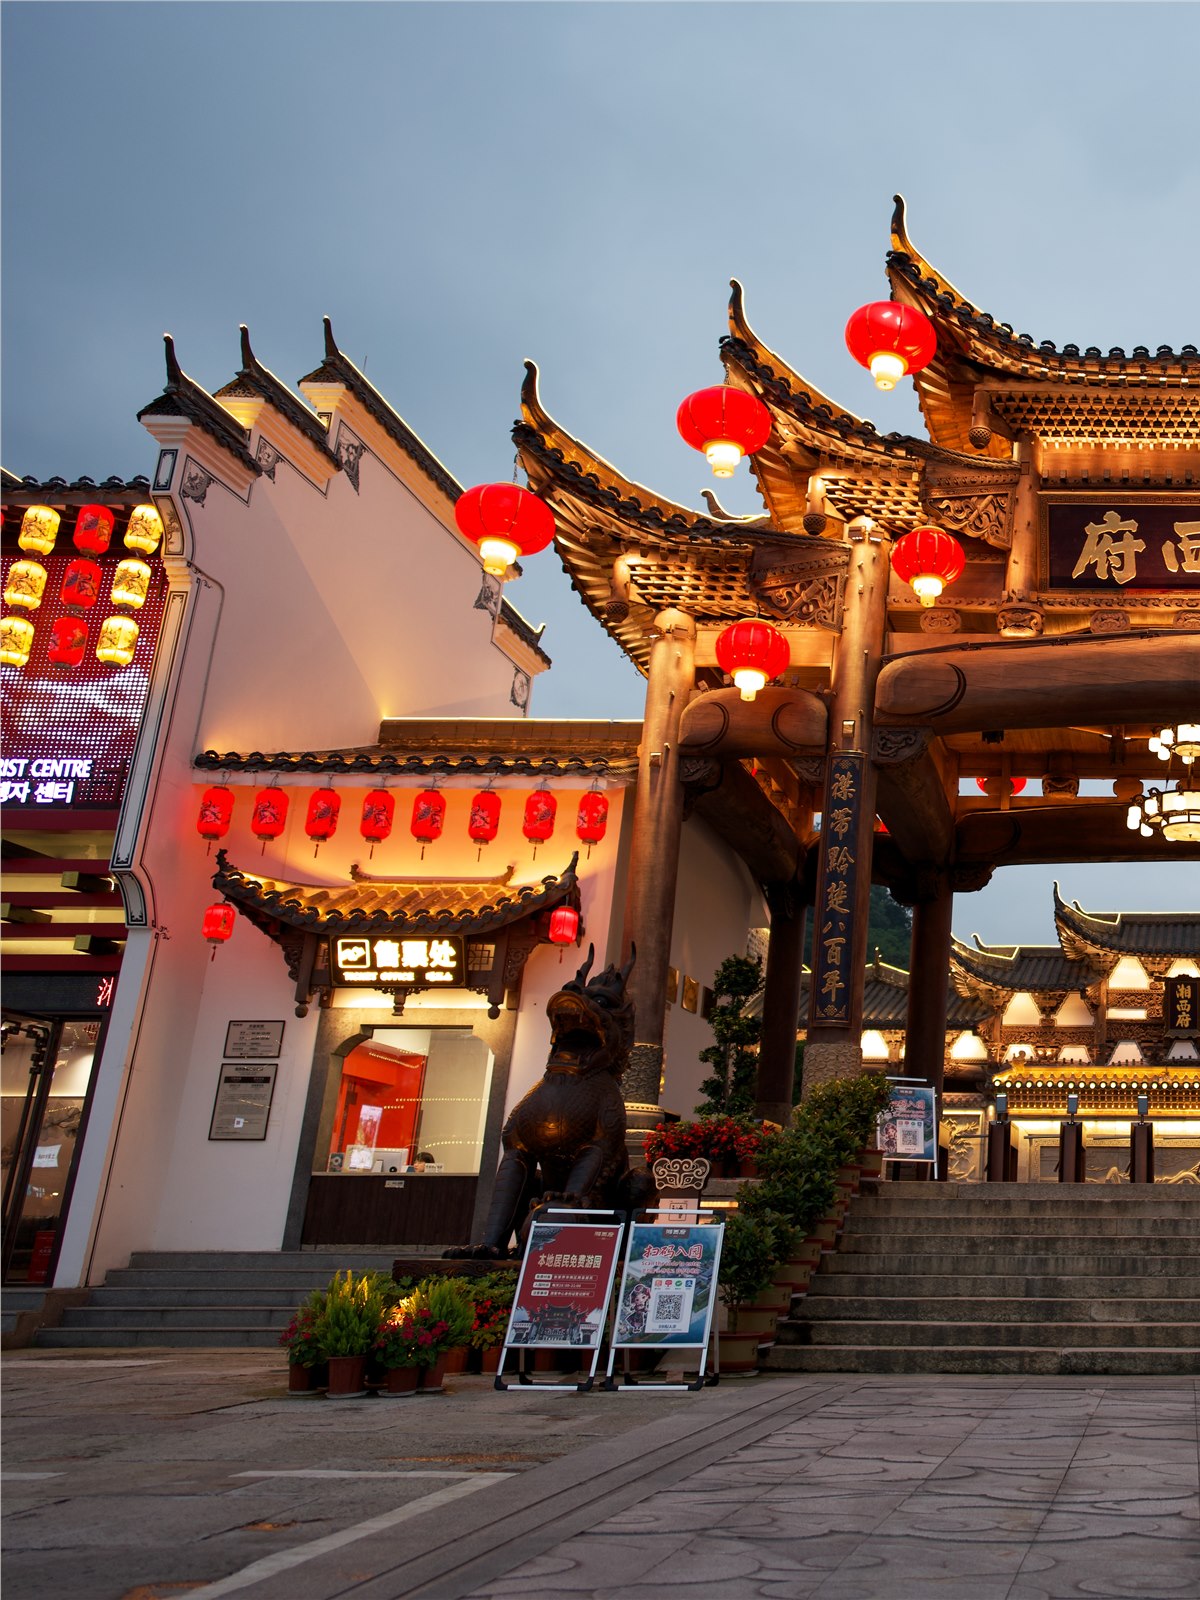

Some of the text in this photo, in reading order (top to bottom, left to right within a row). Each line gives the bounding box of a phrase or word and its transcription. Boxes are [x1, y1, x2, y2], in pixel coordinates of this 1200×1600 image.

[31, 758, 93, 777] CENTRE
[34, 781, 75, 803] 센터
[373, 940, 457, 968] 售票处
[1176, 983, 1192, 1028] 湘西府
[538, 1253, 603, 1269] 本地居民免费游园
[643, 1243, 704, 1261] 扫码入园
